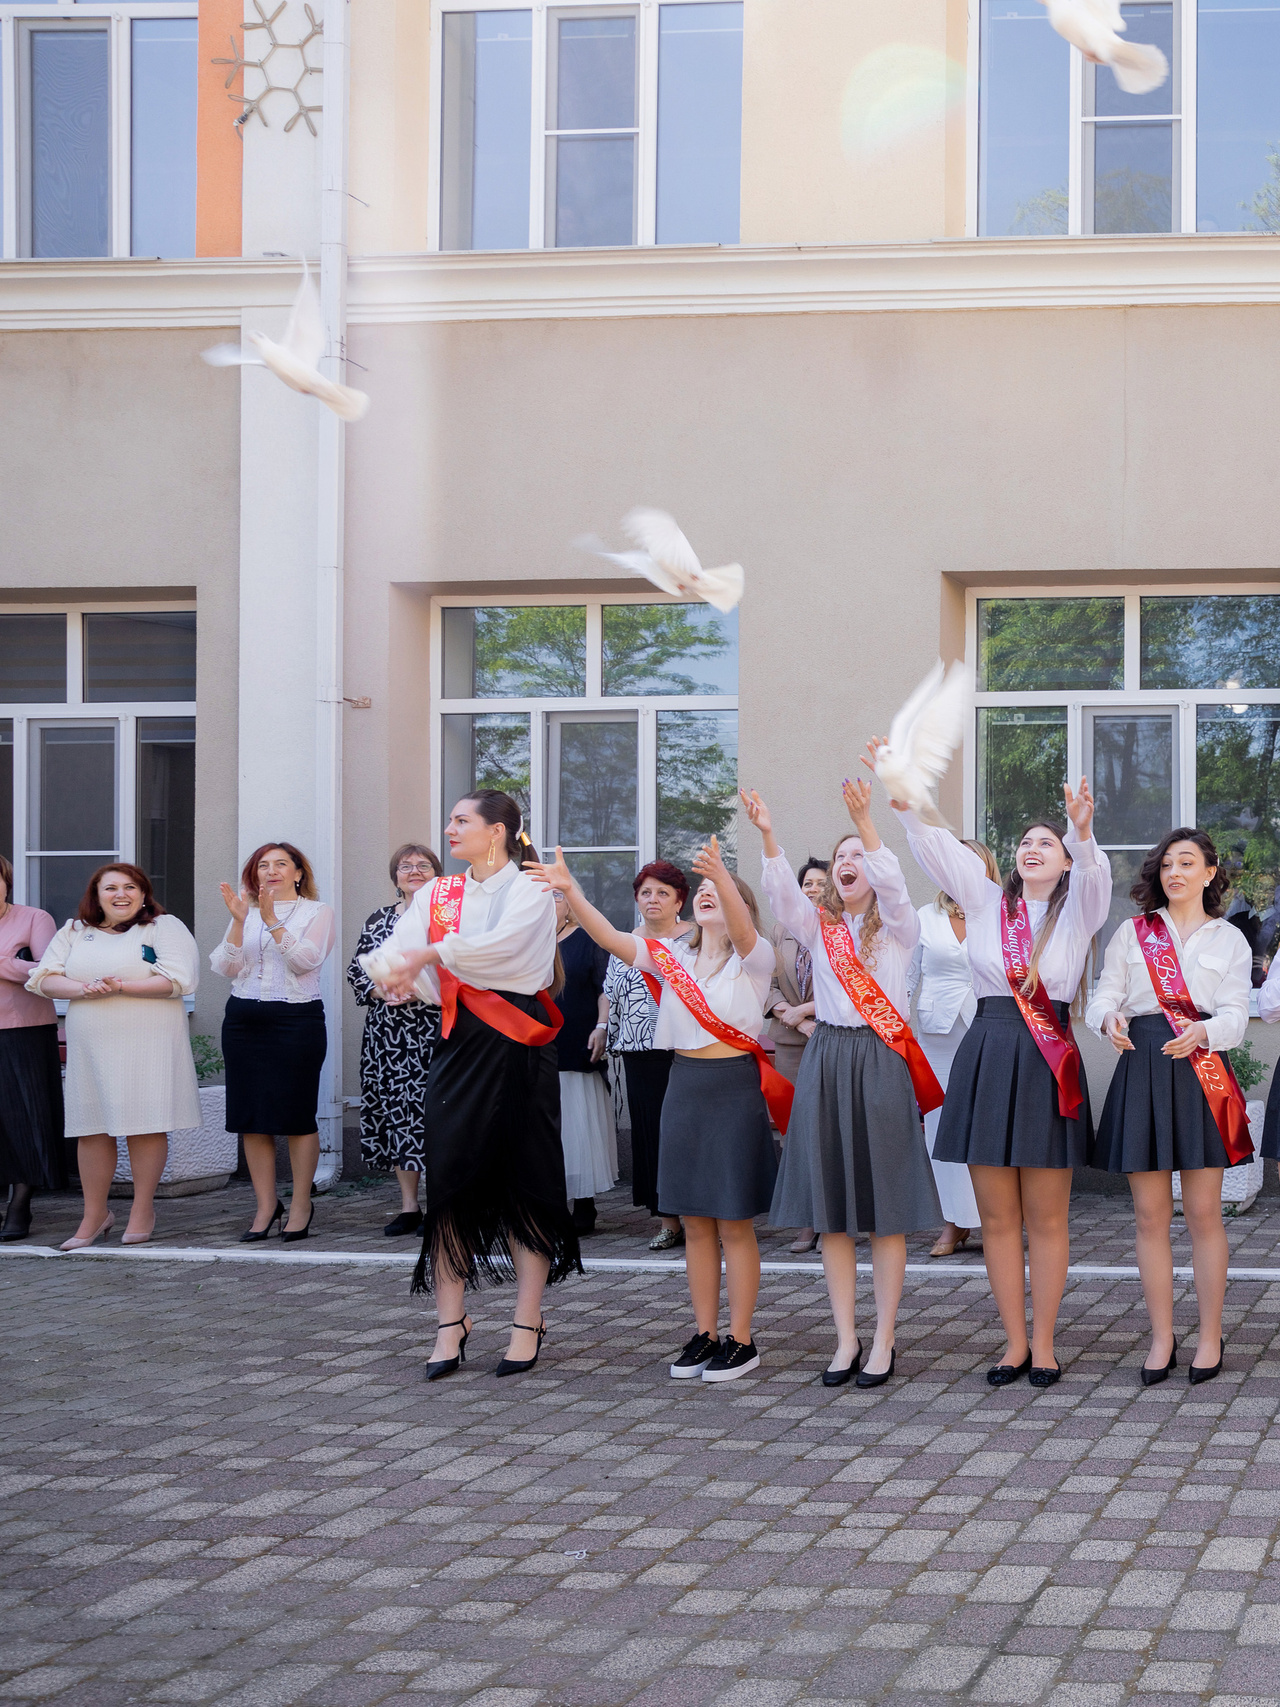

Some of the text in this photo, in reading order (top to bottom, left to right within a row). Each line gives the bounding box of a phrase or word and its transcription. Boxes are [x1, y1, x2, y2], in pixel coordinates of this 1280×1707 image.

[862, 997, 904, 1039] 2022
[1028, 1002, 1059, 1042] 2022
[1194, 1051, 1224, 1092] 2022
